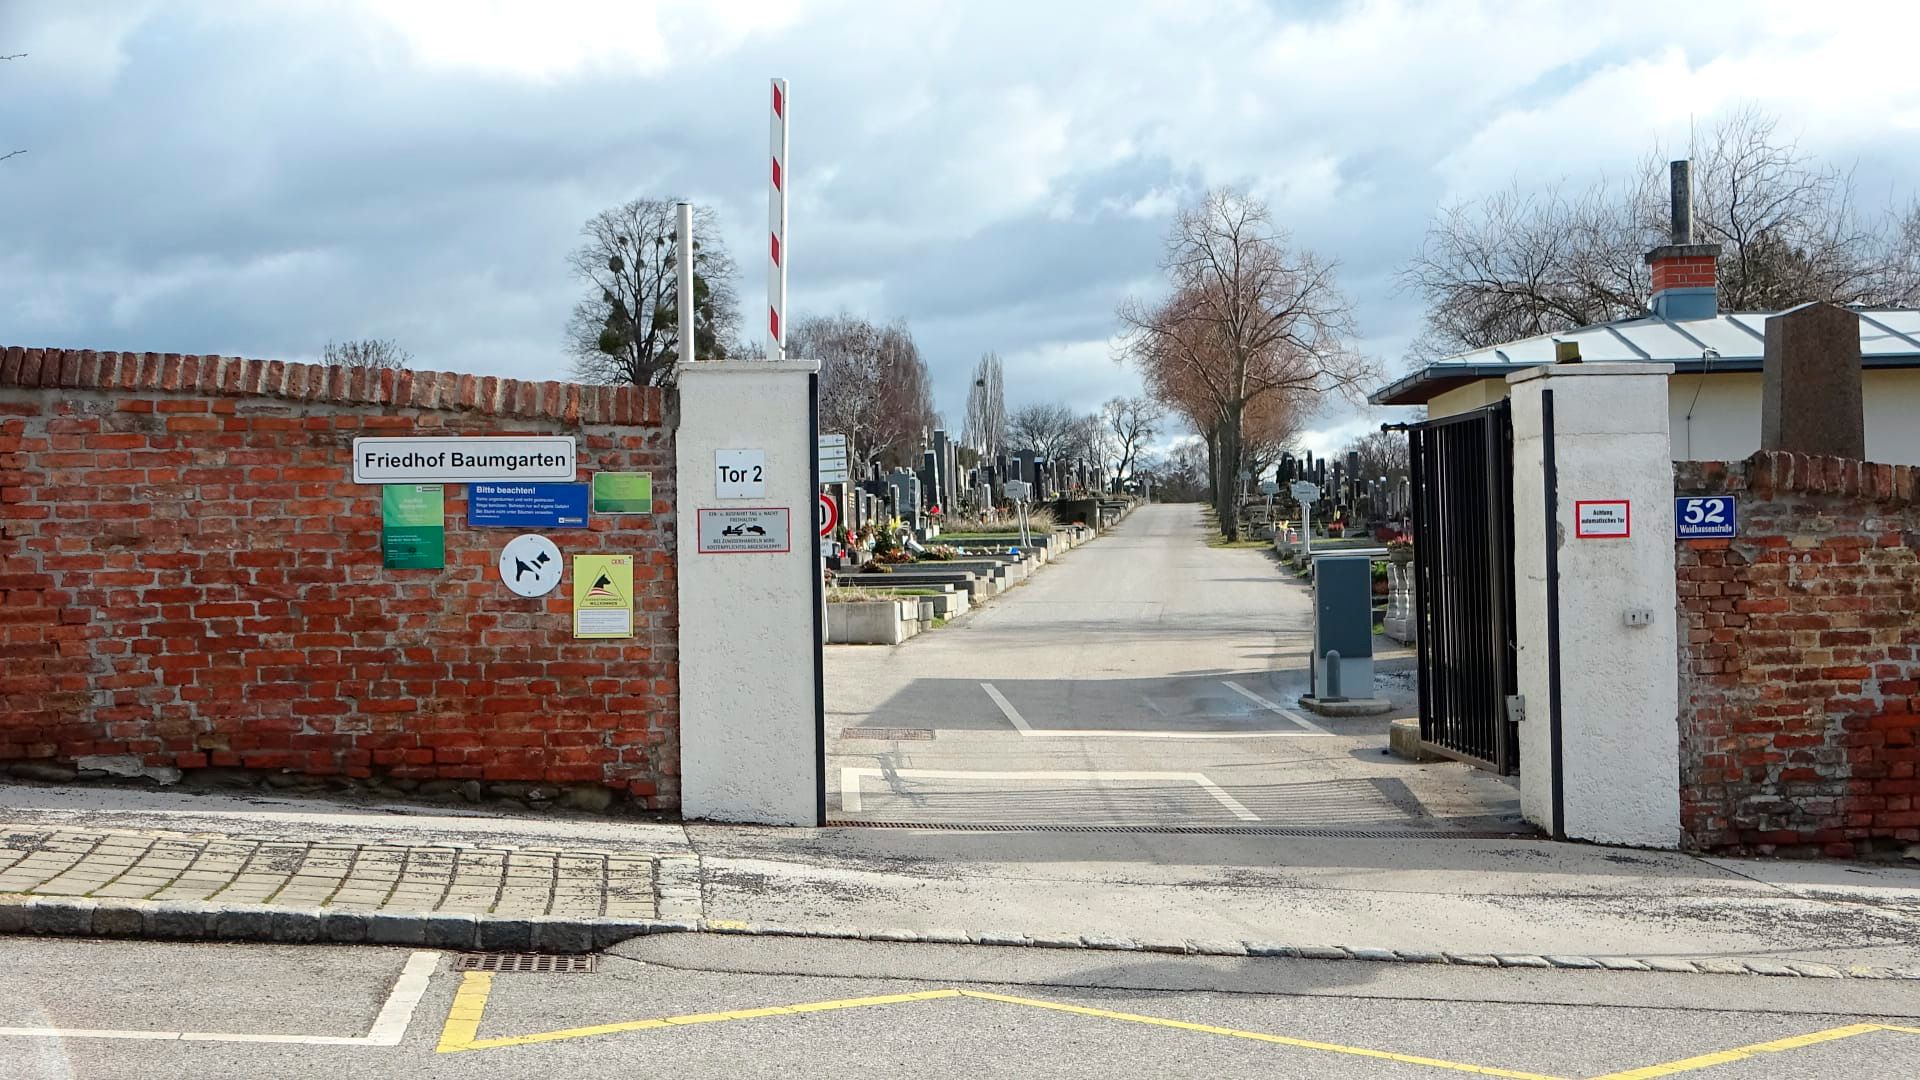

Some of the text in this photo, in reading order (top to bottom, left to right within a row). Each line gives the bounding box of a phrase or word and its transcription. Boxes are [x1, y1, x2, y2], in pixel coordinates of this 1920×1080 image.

[365, 452, 566, 470] Friedhof Baumgarten
[718, 465, 763, 483] Tor 2
[476, 486, 536, 494] Bitte beachten!
[1593, 509, 1613, 517] Achtung
[1684, 498, 1725, 524] 52
